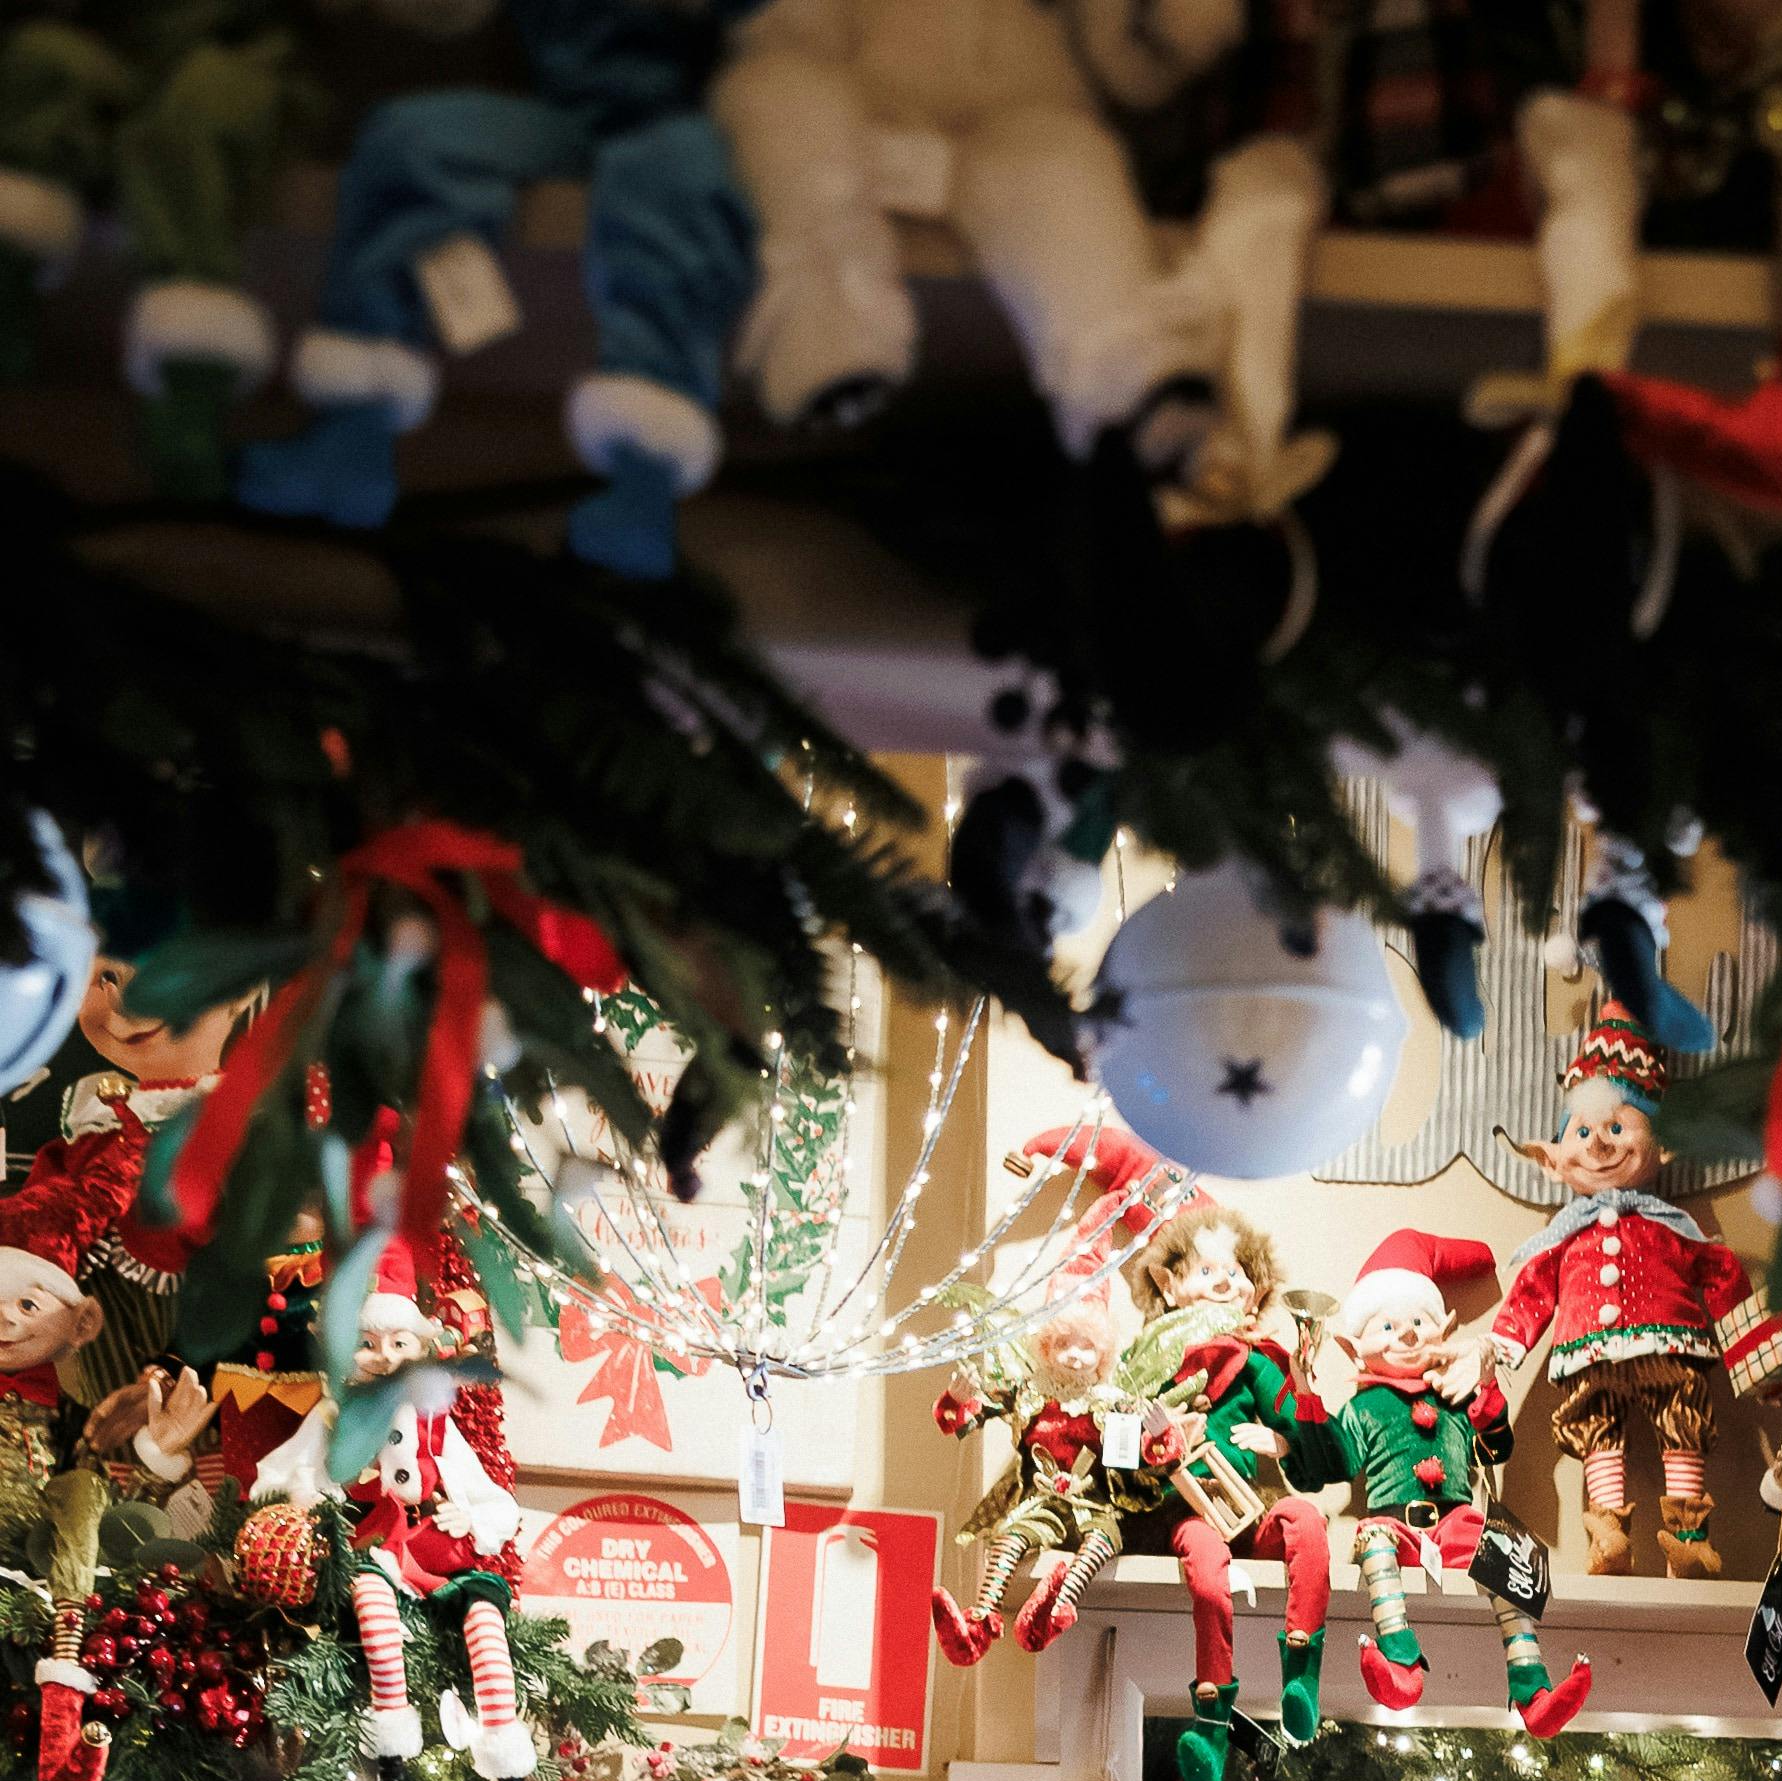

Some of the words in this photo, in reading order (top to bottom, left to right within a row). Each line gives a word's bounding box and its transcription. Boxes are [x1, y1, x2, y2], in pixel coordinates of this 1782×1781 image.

[600, 1538, 652, 1560] DRY
[563, 1557, 688, 1582] CHEMICAL
[628, 1582, 676, 1599] CLASS
[818, 1697, 866, 1723] FIRE
